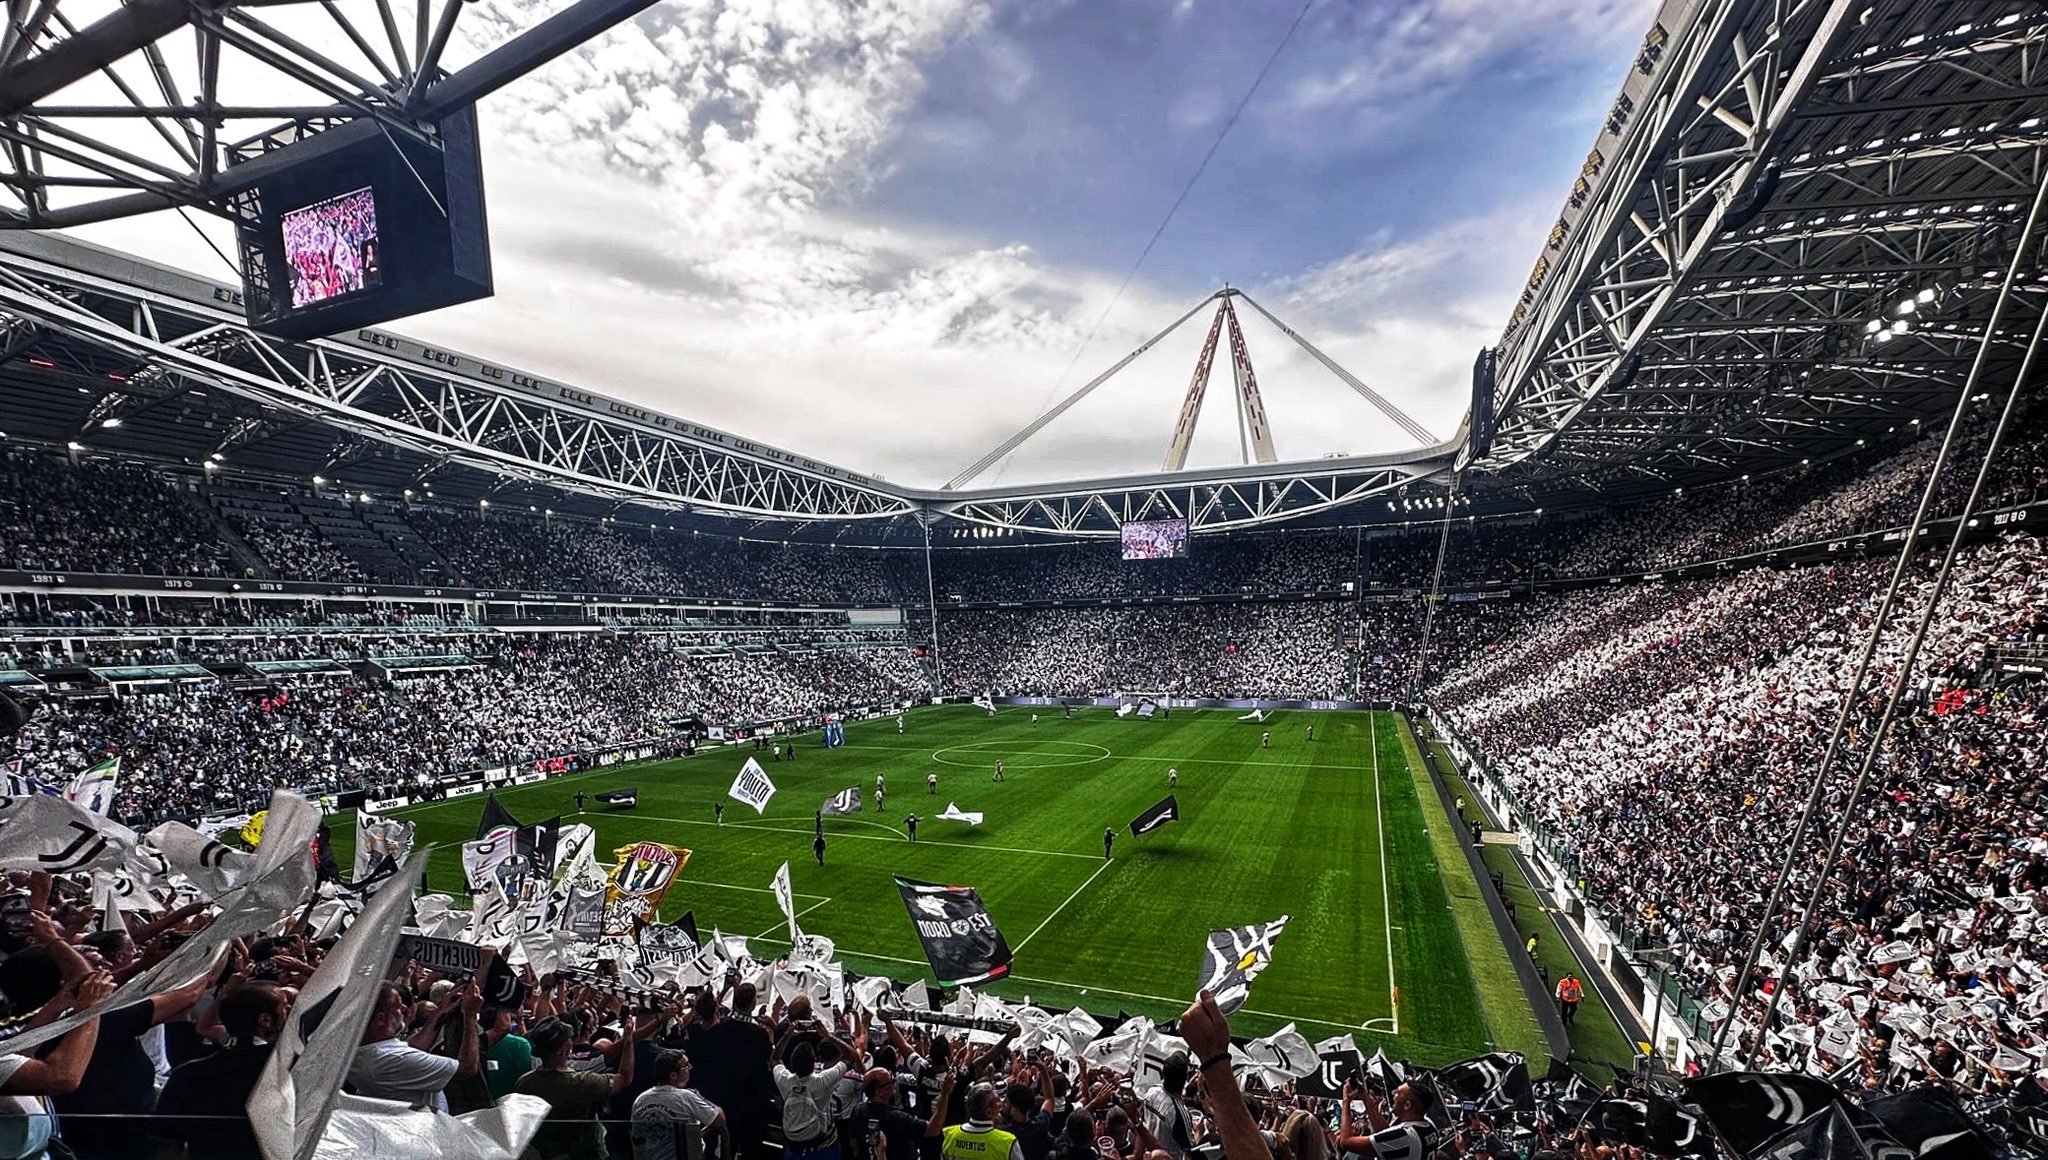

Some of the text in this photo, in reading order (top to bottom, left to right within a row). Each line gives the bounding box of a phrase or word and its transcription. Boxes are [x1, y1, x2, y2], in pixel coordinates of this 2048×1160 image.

[522, 773, 540, 783] Jeep
[455, 785, 475, 795] Jeep
[738, 766, 771, 803] YOUTH
[376, 799, 399, 809] Jeep
[917, 912, 992, 938] NORD EST
[954, 1139, 986, 1152] JUVENTUS
